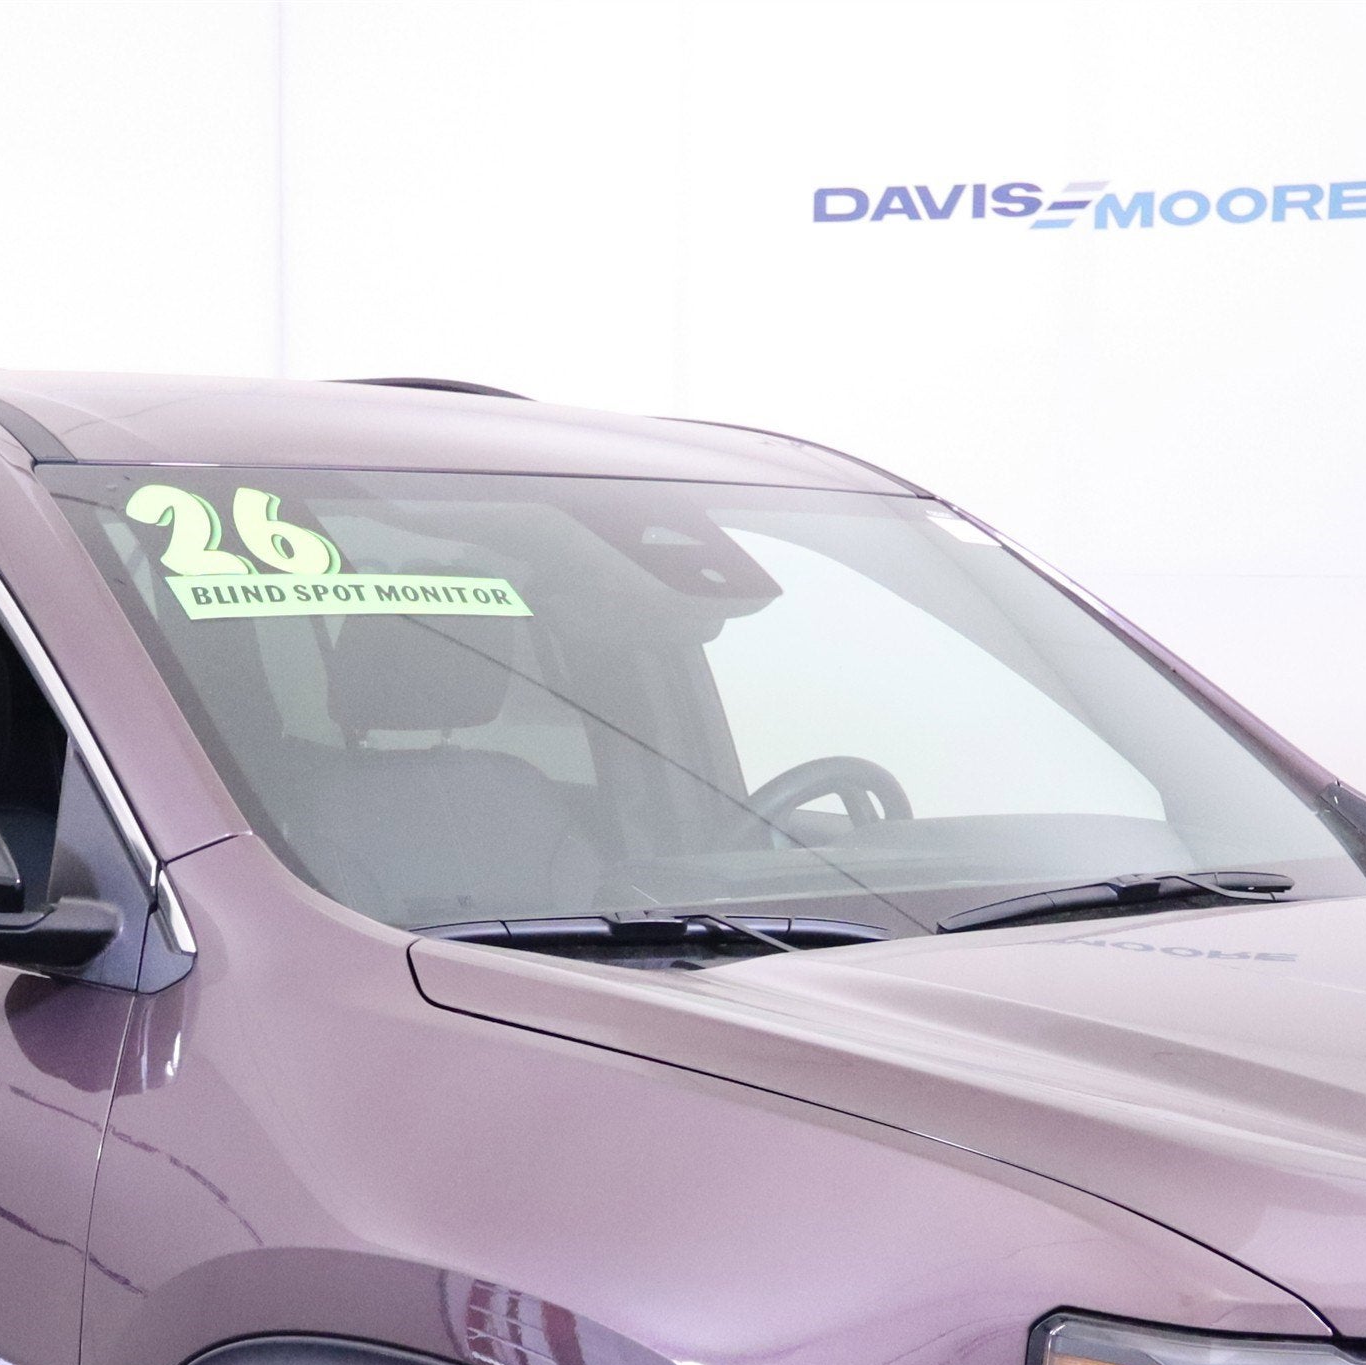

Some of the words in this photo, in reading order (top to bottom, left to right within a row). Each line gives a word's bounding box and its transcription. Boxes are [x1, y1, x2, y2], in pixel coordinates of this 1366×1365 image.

[813, 182, 1044, 223] DAVIS
[126, 484, 341, 575] 26
[191, 583, 286, 606] BLIND
[292, 583, 366, 603] SPOT
[374, 584, 513, 606] MONITOR
